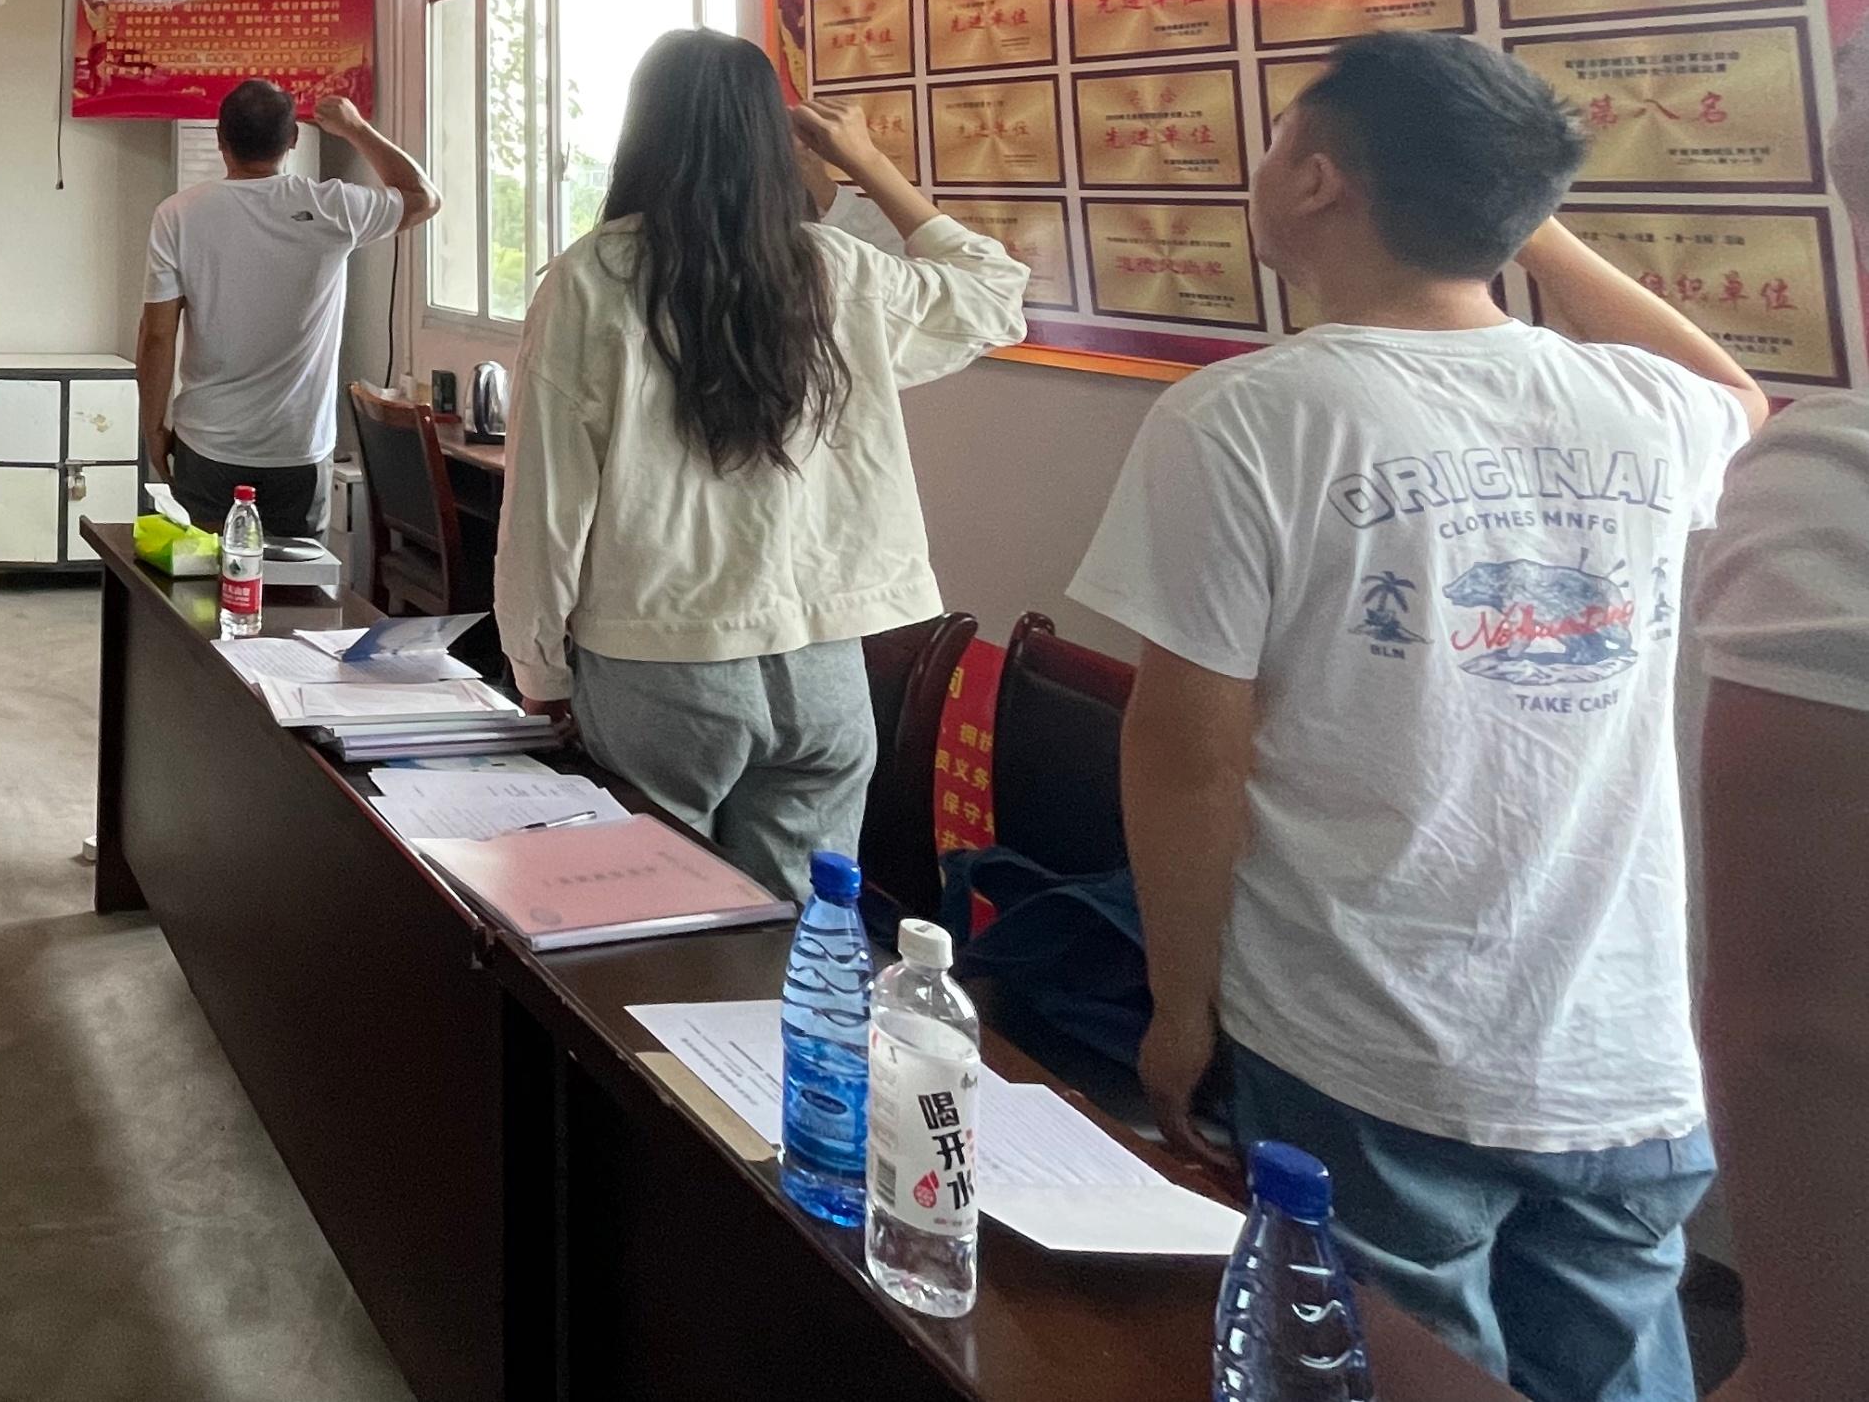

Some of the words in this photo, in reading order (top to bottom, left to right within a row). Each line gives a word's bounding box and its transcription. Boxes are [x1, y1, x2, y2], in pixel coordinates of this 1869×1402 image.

[1589, 91, 1728, 129] 第八名
[1105, 124, 1216, 149] 先进单位
[1327, 447, 1674, 529] ORIGINAL
[1438, 509, 1535, 540] CLOTHES
[1542, 509, 1619, 536] MNFG
[1516, 694, 1573, 714] TAKE
[917, 1091, 976, 1210] 喝开水
